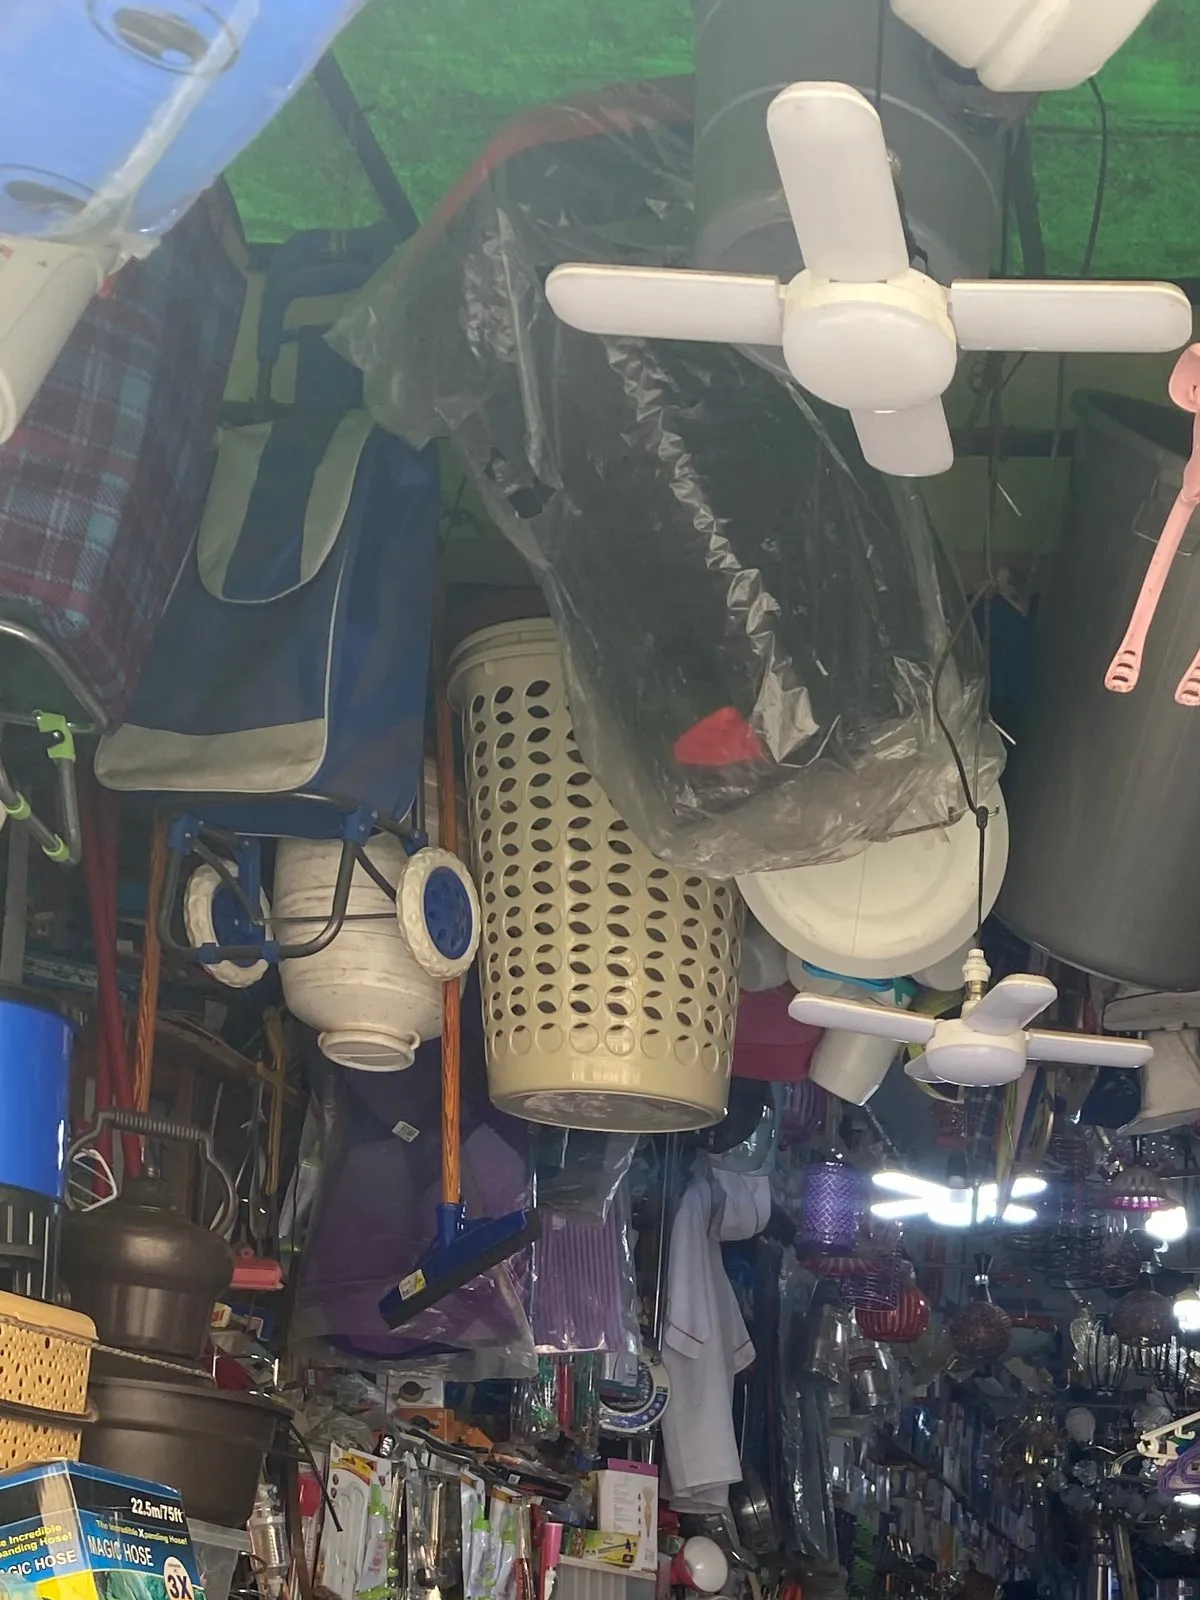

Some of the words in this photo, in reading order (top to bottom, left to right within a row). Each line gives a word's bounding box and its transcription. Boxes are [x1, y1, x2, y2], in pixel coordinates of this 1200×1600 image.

[131, 1497, 184, 1523] 22.5m/75ft
[9, 1524, 62, 1544] Incredible
[40, 1531, 73, 1546] Hose!
[35, 1549, 78, 1571] HOSE
[88, 1535, 122, 1560] MAGIC
[123, 1542, 154, 1567] HOSE
[167, 1574, 193, 1600] 3X
